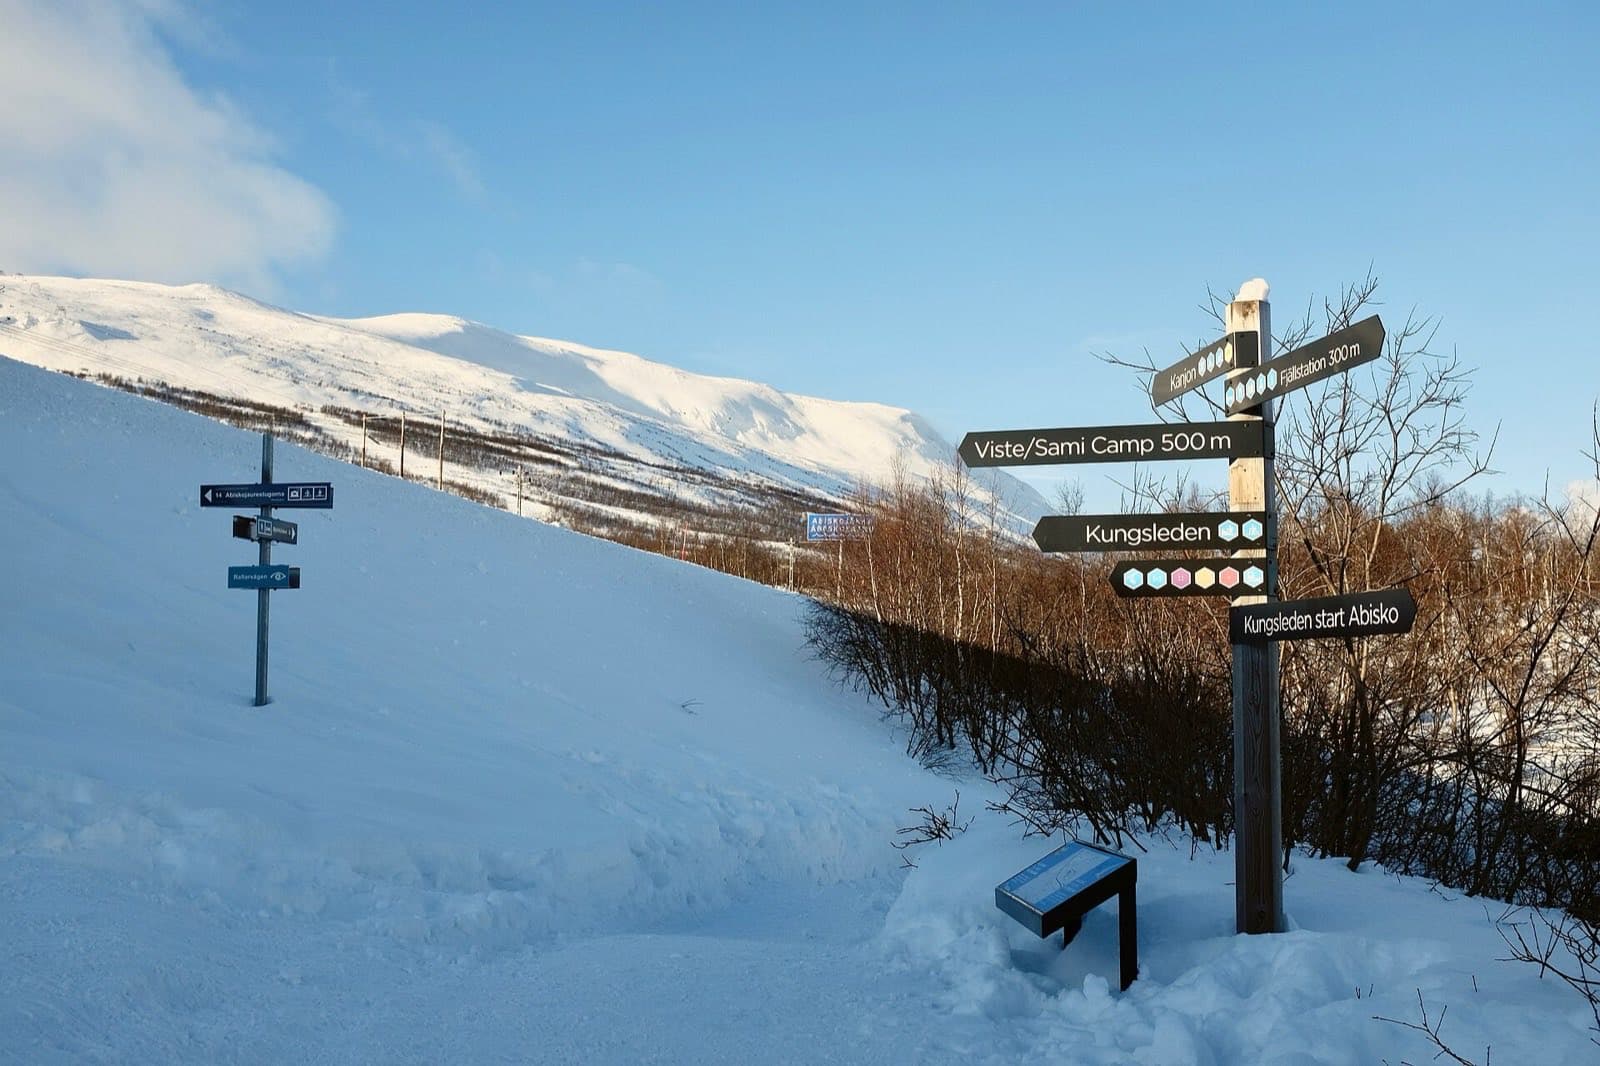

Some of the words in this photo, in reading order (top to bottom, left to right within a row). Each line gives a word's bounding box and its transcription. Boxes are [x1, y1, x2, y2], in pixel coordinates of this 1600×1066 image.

[1280, 357, 1327, 387] Fjällstation
[1328, 343, 1350, 367] 300
[1349, 342, 1361, 357] m
[1170, 366, 1197, 393] Kanjon
[974, 436, 1085, 460] Viste/Sami
[1091, 435, 1155, 457] Camp
[1161, 432, 1206, 452] 500
[1210, 433, 1232, 450] m
[1086, 522, 1211, 546] Kungsleden
[1244, 609, 1312, 637] Kungsleden
[1315, 607, 1345, 630] start
[1348, 602, 1399, 627] Abisko
